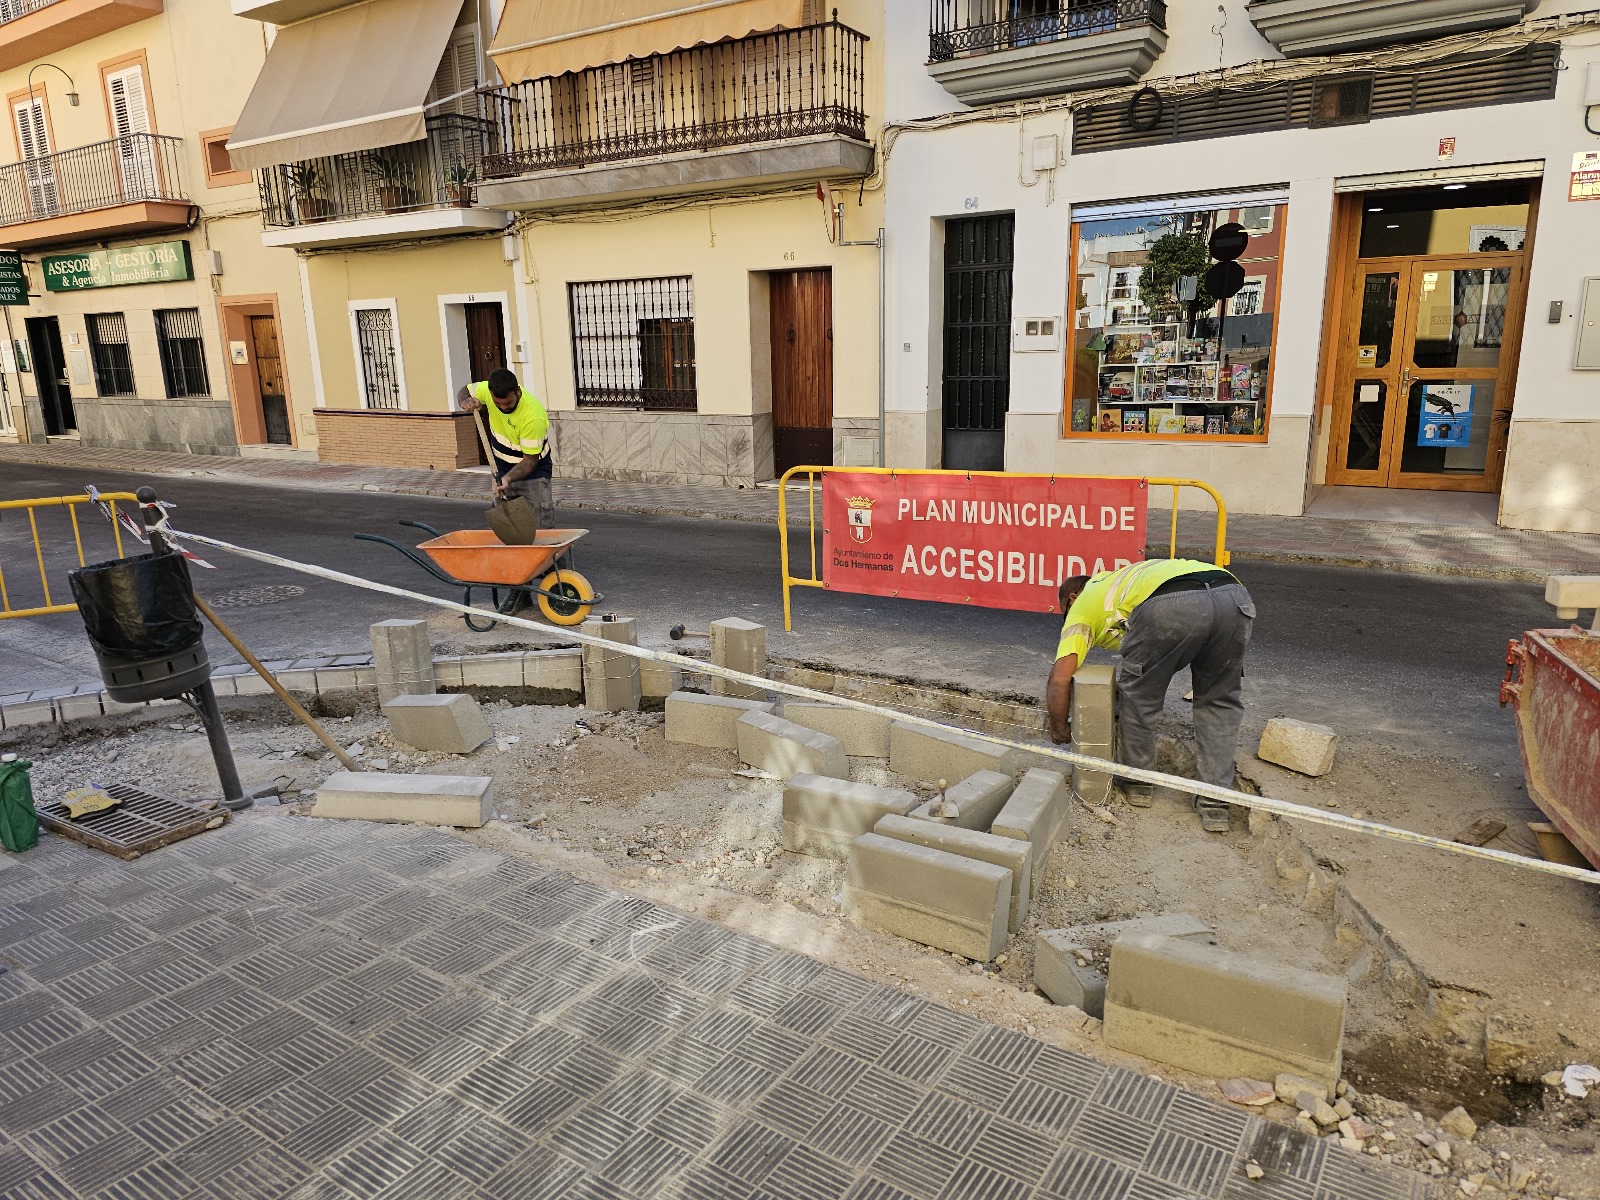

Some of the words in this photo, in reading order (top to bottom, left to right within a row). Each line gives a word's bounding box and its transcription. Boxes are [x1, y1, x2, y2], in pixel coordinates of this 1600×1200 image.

[964, 196, 979, 210] 64
[783, 251, 795, 261] 66
[62, 276, 70, 287] &
[72, 274, 107, 288] Agencia
[111, 267, 170, 283] Inmobiliaria
[898, 498, 956, 523] PLAN
[962, 499, 1094, 531] MUNICIPAL
[1101, 505, 1135, 532] DE
[833, 547, 881, 560] Ayuntamiento
[883, 552, 894, 560] de
[833, 557, 849, 568] Dos
[851, 559, 894, 572] Hermanas
[901, 544, 1132, 588] ACCESIBILIDA
